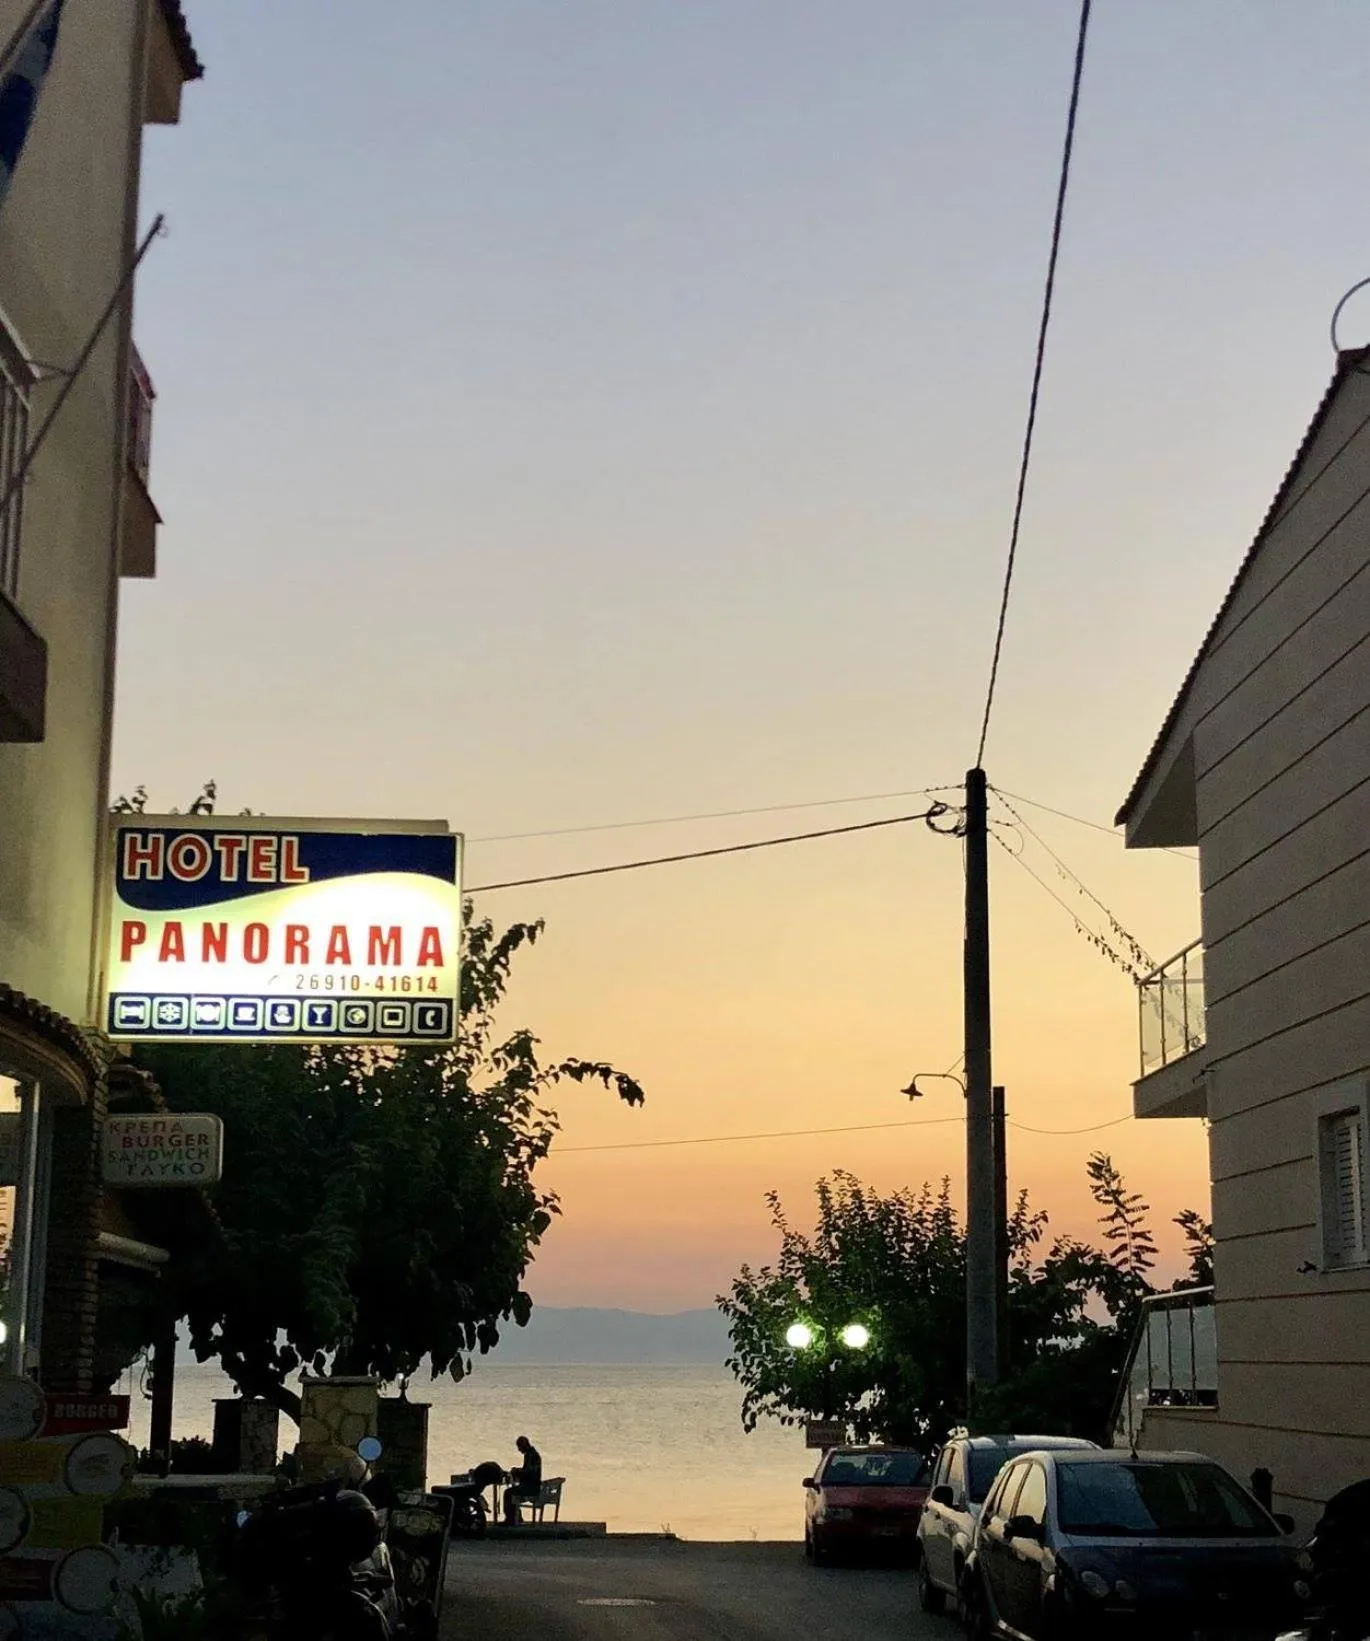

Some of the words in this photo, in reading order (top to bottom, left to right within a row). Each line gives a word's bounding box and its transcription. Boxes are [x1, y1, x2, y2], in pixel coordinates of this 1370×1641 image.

[123, 834, 309, 882] HOTEL
[121, 921, 444, 966] PANORAMA
[296, 974, 438, 992] 26910-41614
[122, 1134, 209, 1148] BURGER
[109, 1148, 209, 1163] SANDWICH
